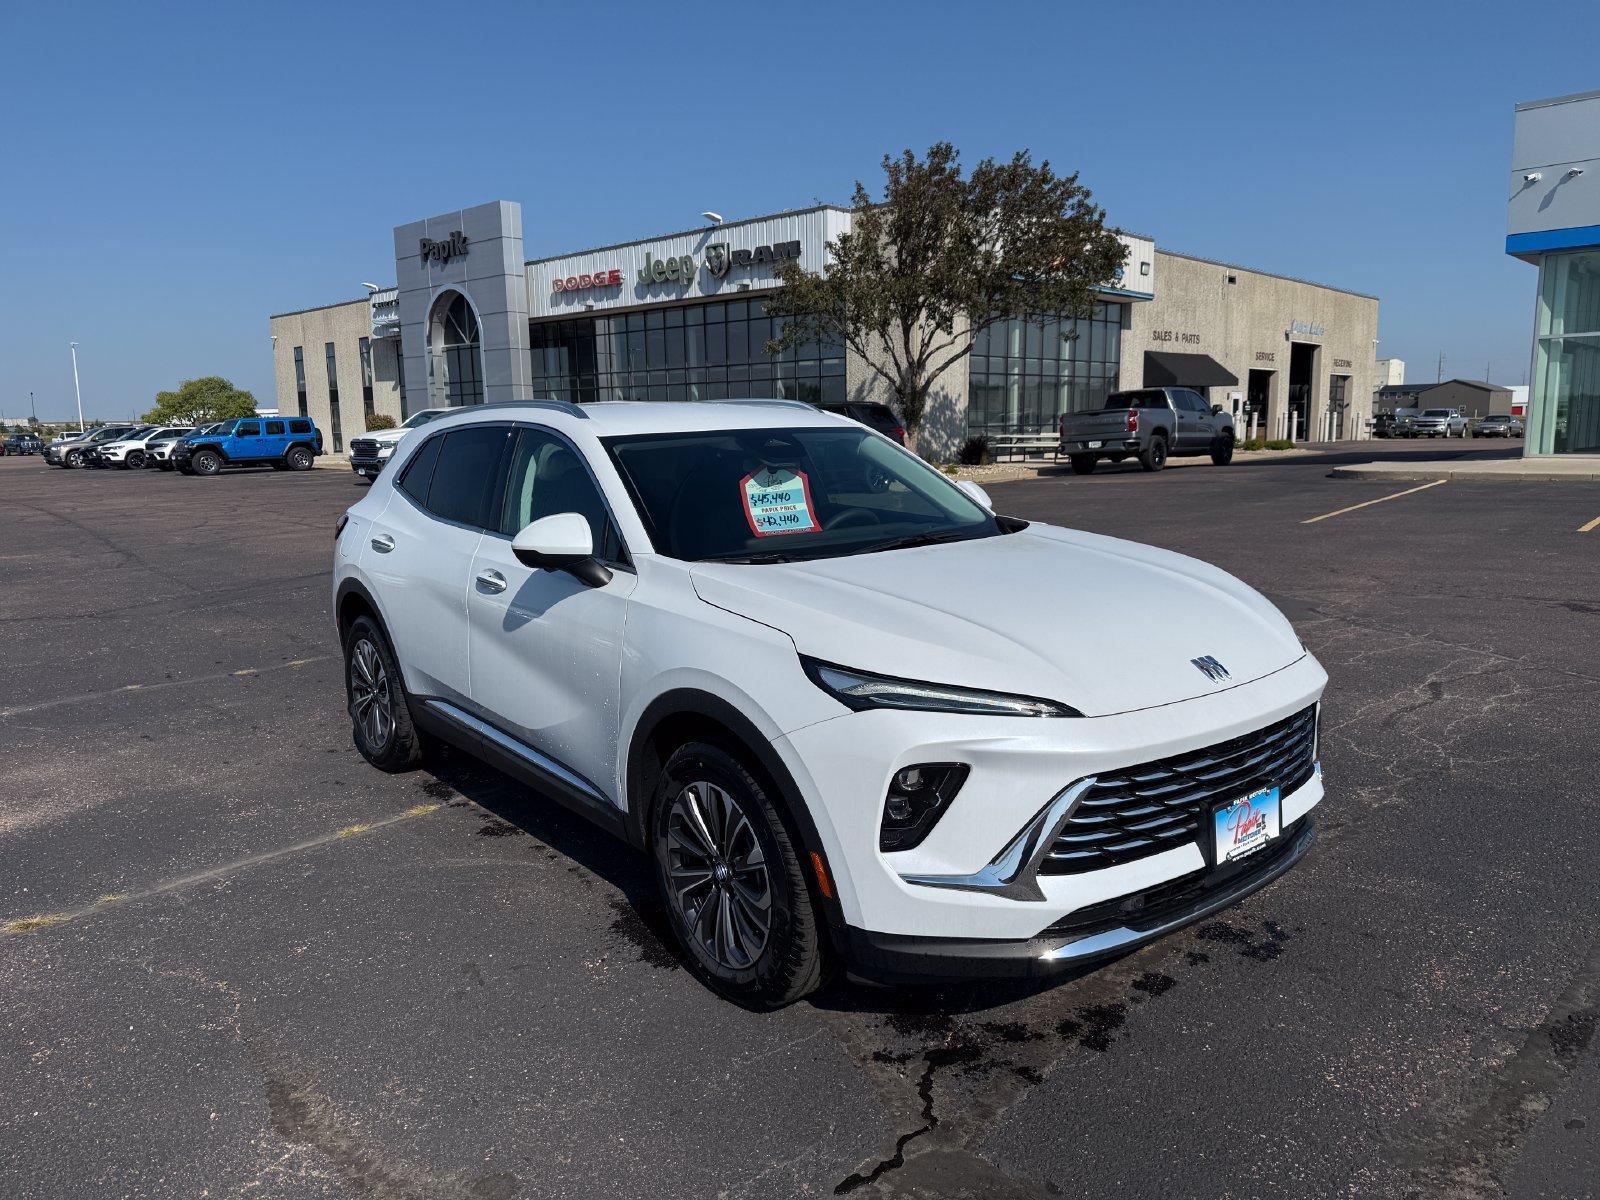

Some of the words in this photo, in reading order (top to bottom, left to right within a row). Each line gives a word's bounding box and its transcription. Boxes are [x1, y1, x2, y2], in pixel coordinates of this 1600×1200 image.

[420, 231, 468, 264] Papik
[732, 240, 800, 266] RAM
[638, 252, 695, 284] Jeep
[552, 269, 622, 293] DODGE
[1152, 330, 1172, 342] SALES
[1175, 331, 1179, 342] &
[1181, 332, 1200, 344] PARTS
[1255, 351, 1275, 362] SERVICE
[751, 493, 791, 506] $45,440
[756, 514, 800, 527] $42,440
[1227, 801, 1260, 844] Papik
